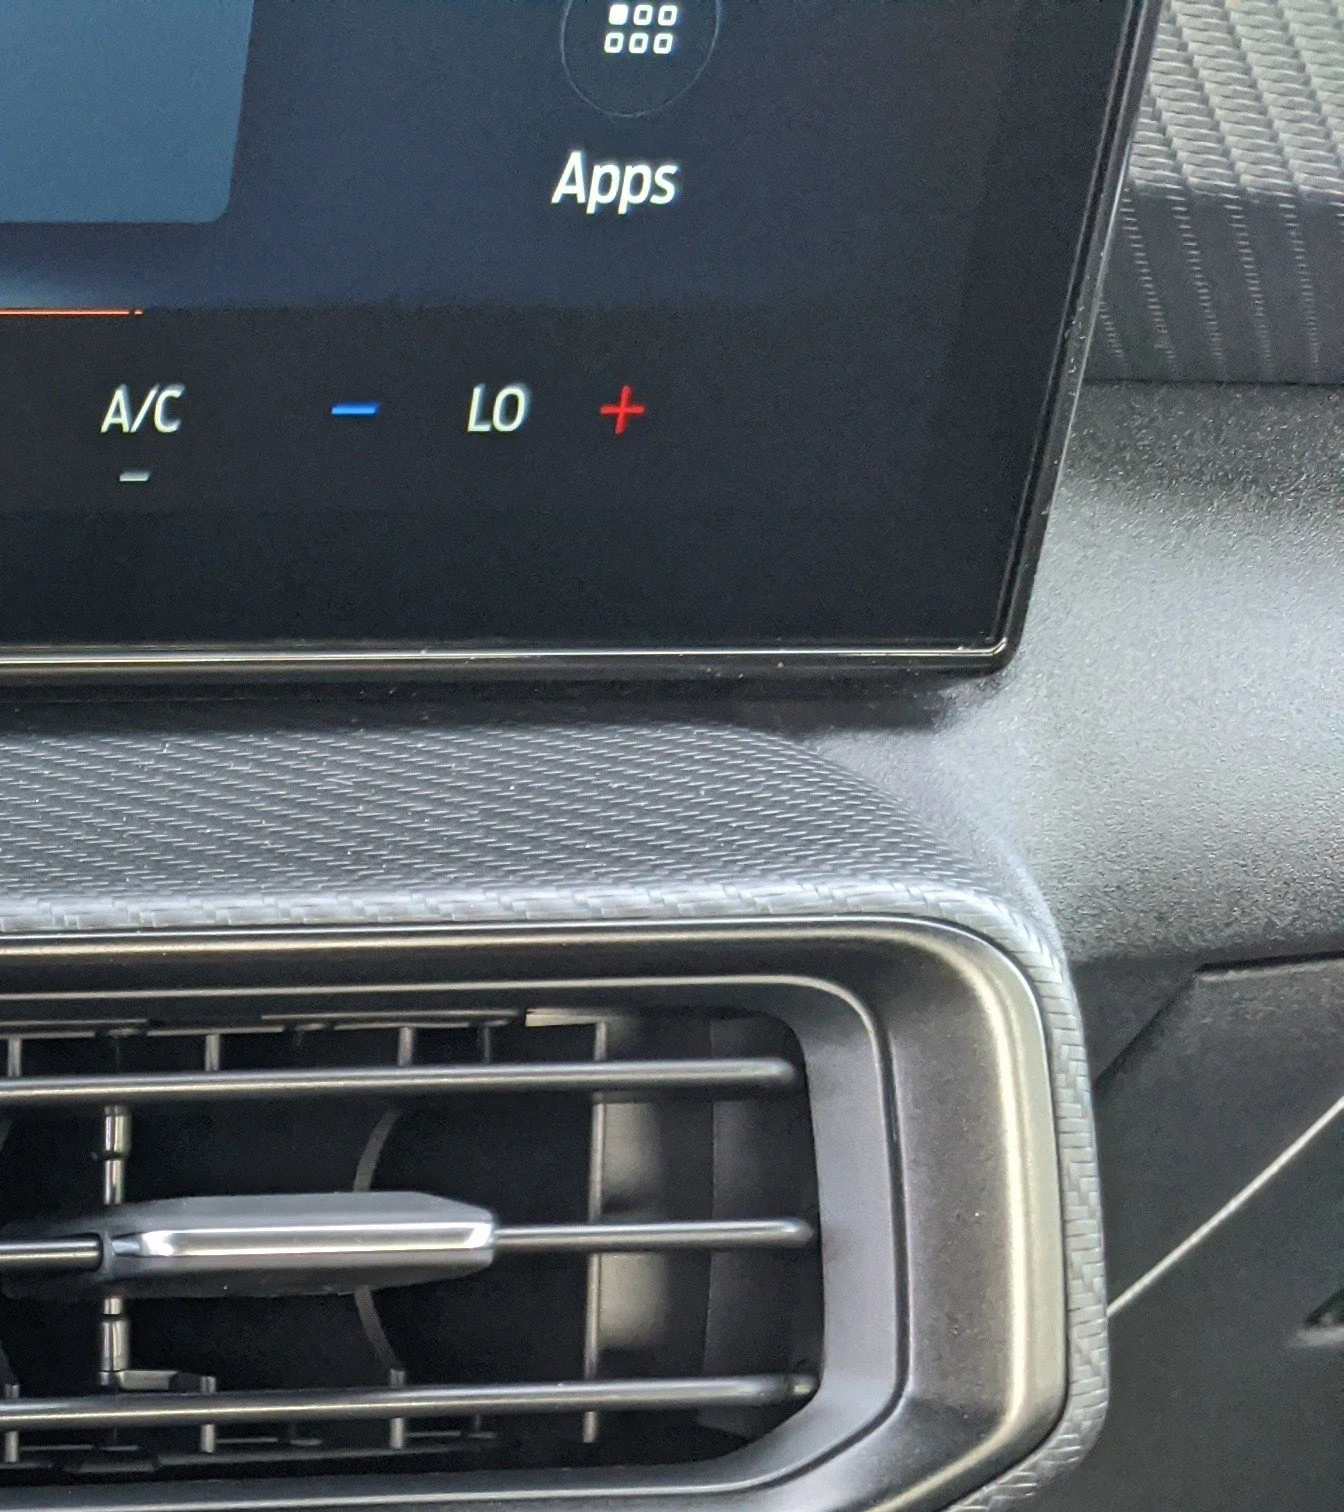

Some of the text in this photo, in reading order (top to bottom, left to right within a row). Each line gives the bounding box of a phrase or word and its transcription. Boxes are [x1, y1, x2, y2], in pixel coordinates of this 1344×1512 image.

[551, 150, 678, 213] Apps
[101, 385, 185, 434] A/C
[466, 385, 529, 434] LO
